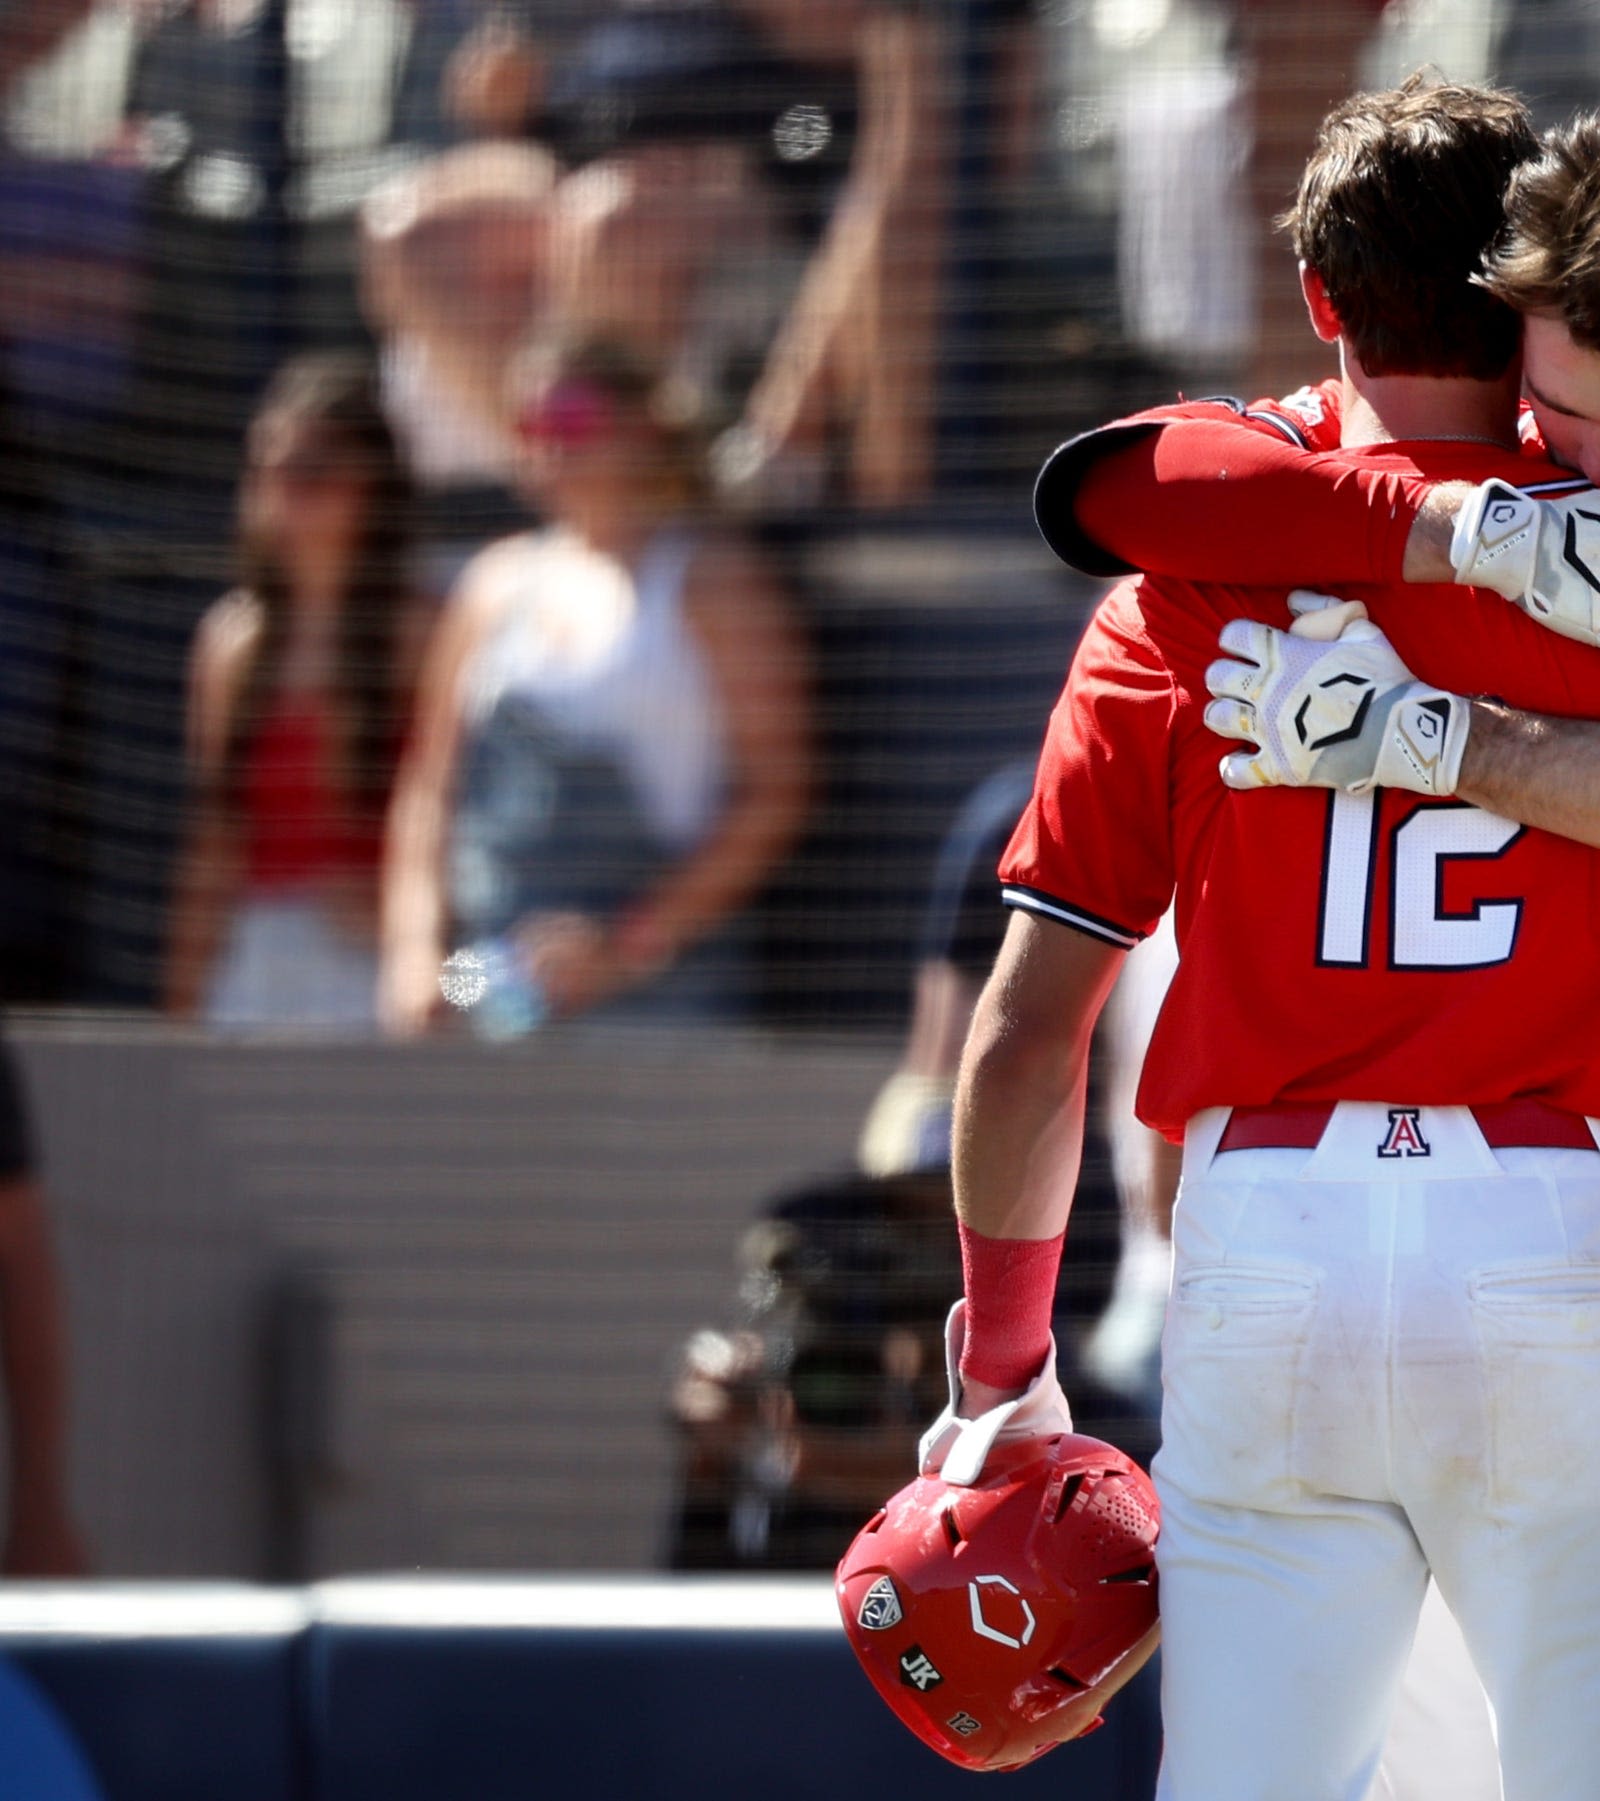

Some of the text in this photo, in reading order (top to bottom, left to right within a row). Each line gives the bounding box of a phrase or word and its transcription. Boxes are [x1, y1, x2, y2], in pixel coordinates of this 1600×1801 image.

[1314, 786, 1530, 972] 12
[1377, 1108, 1431, 1159] A
[901, 1654, 940, 1690] JK
[947, 1712, 981, 1737] 12
